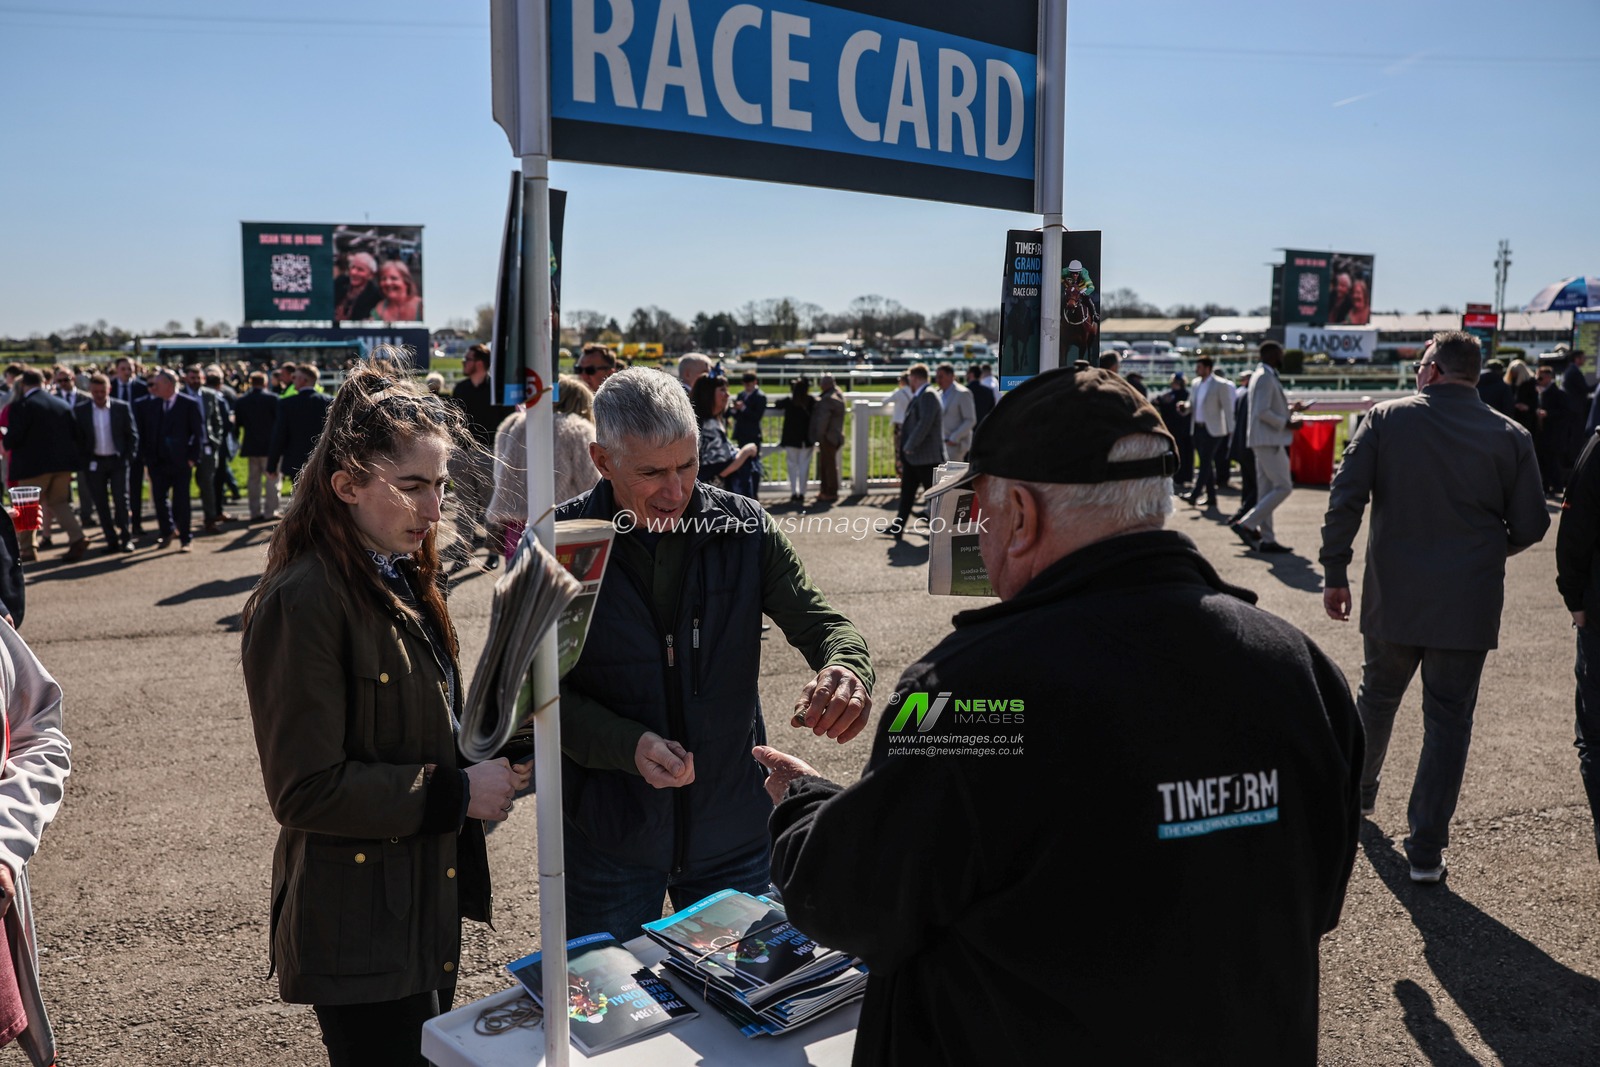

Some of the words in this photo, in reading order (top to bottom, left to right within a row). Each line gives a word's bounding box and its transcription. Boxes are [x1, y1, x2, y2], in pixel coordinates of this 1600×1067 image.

[571, 0, 813, 132] RACE
[837, 29, 1025, 162] CARD
[1015, 241, 1042, 255] TIMEFOR
[1014, 256, 1040, 270] GRAND
[1014, 272, 1042, 285] NATION
[1013, 288, 1026, 296] RACE
[1026, 288, 1038, 297] CARD
[1299, 332, 1363, 352] RANDOX
[1157, 768, 1278, 822] TIMEFORM
[607, 984, 670, 1007] NATIONAL
